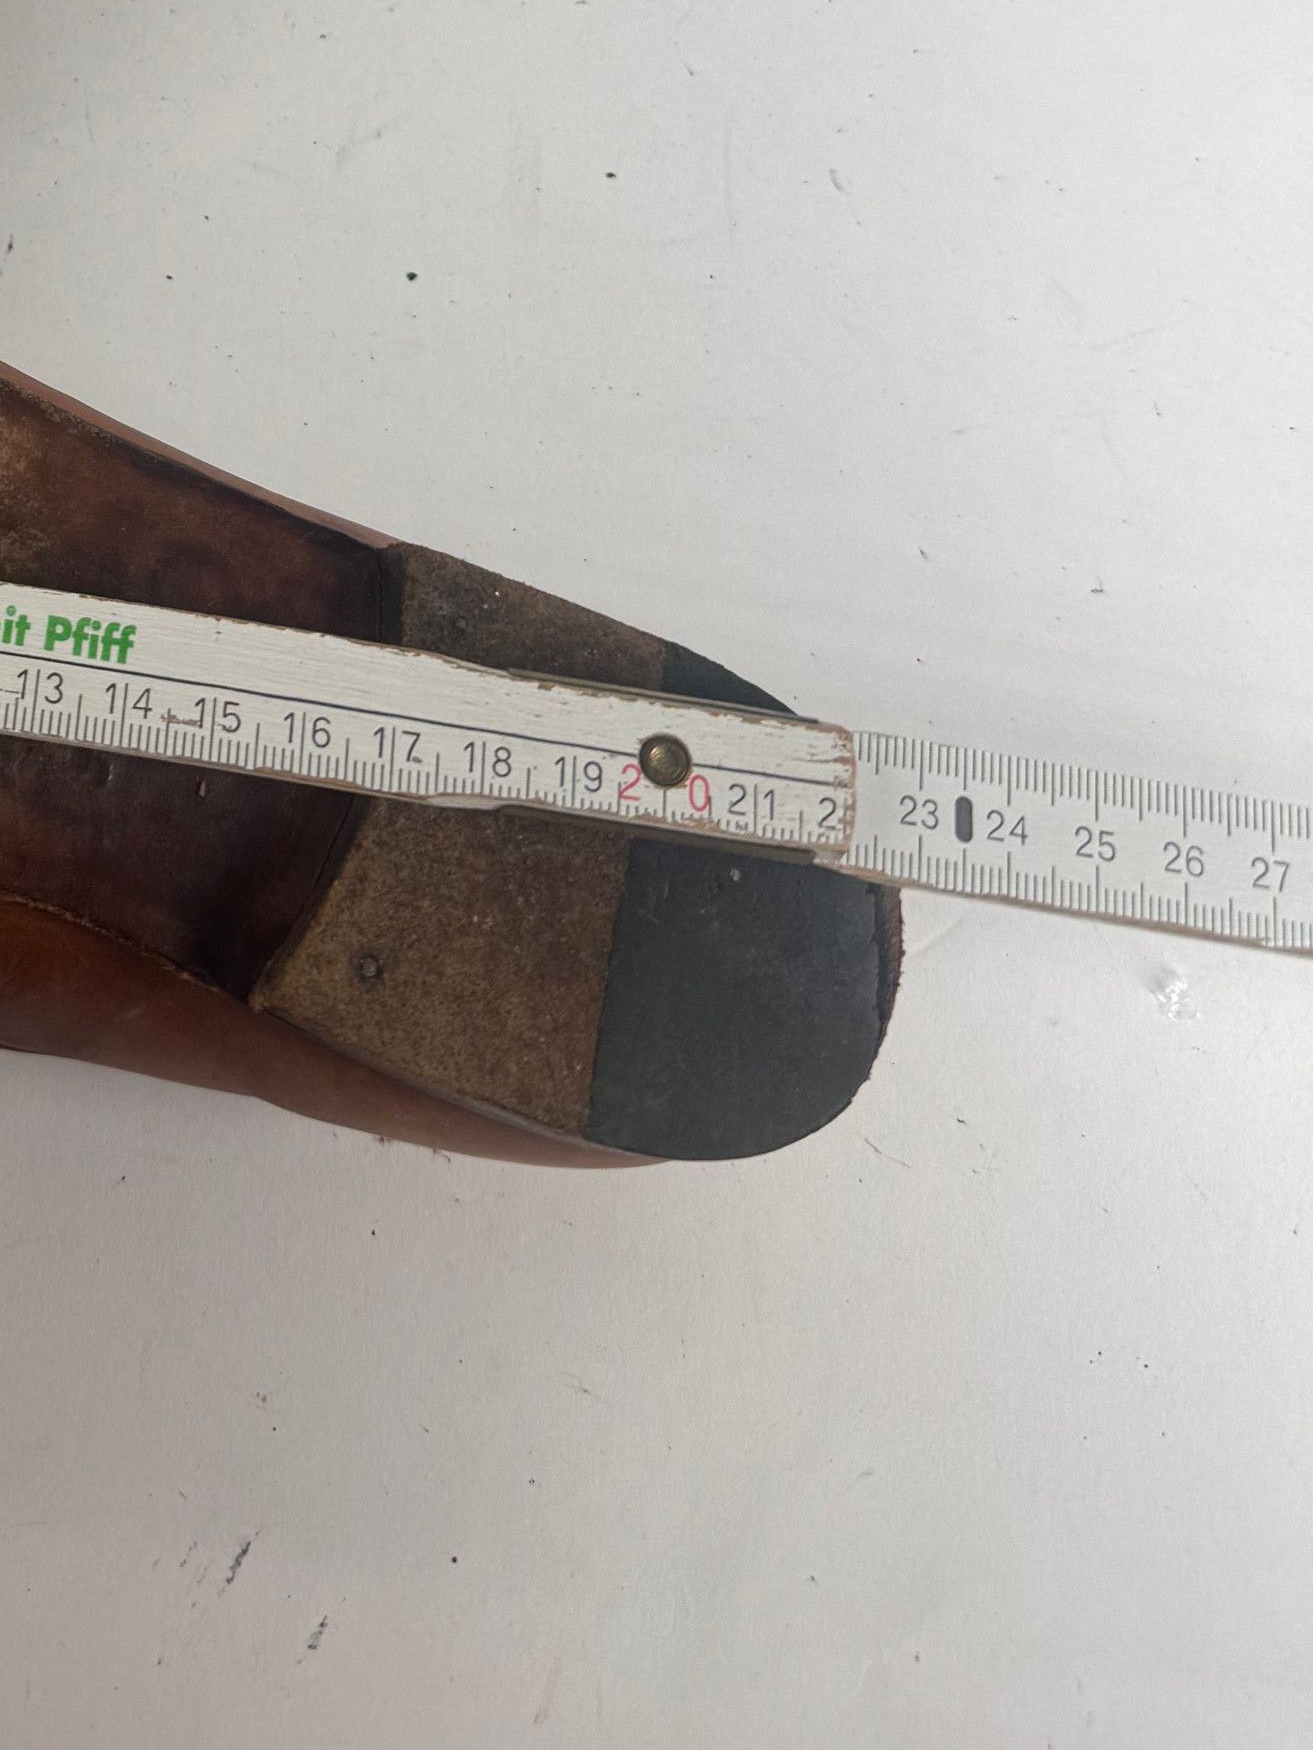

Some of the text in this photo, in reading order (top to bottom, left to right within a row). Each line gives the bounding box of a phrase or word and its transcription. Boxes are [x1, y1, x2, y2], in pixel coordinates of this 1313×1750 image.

[44, 615, 138, 664] Pfiff
[17, 669, 63, 704] 13
[105, 683, 152, 719] 14
[194, 698, 241, 734] 15
[283, 712, 330, 749] 16
[373, 727, 421, 763] 17
[463, 741, 512, 778] 18
[554, 756, 602, 792] 19
[728, 784, 775, 821] 21
[899, 795, 1290, 891] 23 24 25 26 27
